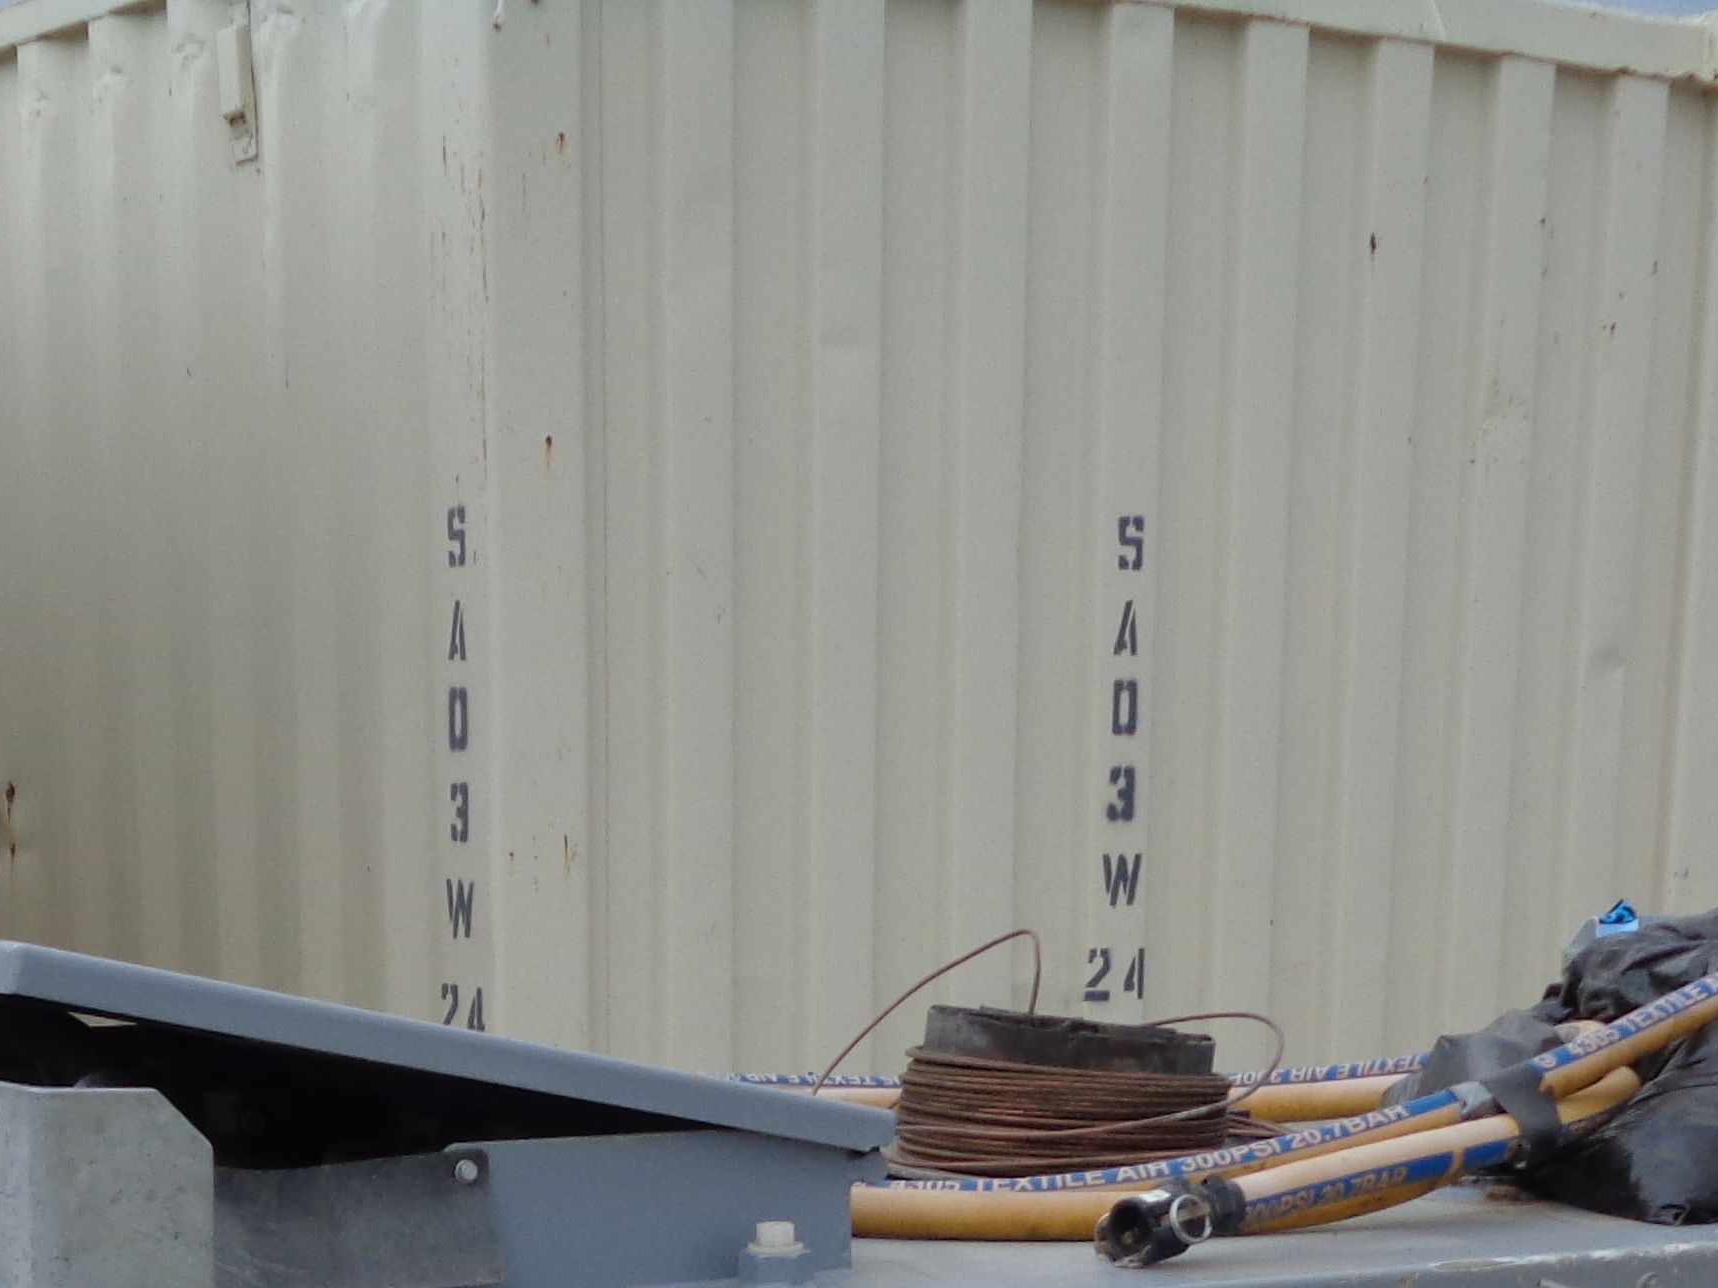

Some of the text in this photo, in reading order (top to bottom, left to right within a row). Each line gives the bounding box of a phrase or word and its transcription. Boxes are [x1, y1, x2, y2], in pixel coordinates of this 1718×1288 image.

[1083, 947, 1146, 1002] 24
[1289, 1064, 1328, 1083] AIR
[1335, 1055, 1422, 1080] TEXTILE
[975, 1169, 1107, 1193] TEXTILE
[1116, 1159, 1172, 1182] AIR
[1179, 1135, 1283, 1173] 300PSI
[1286, 1103, 1410, 1152] 20.7BAR
